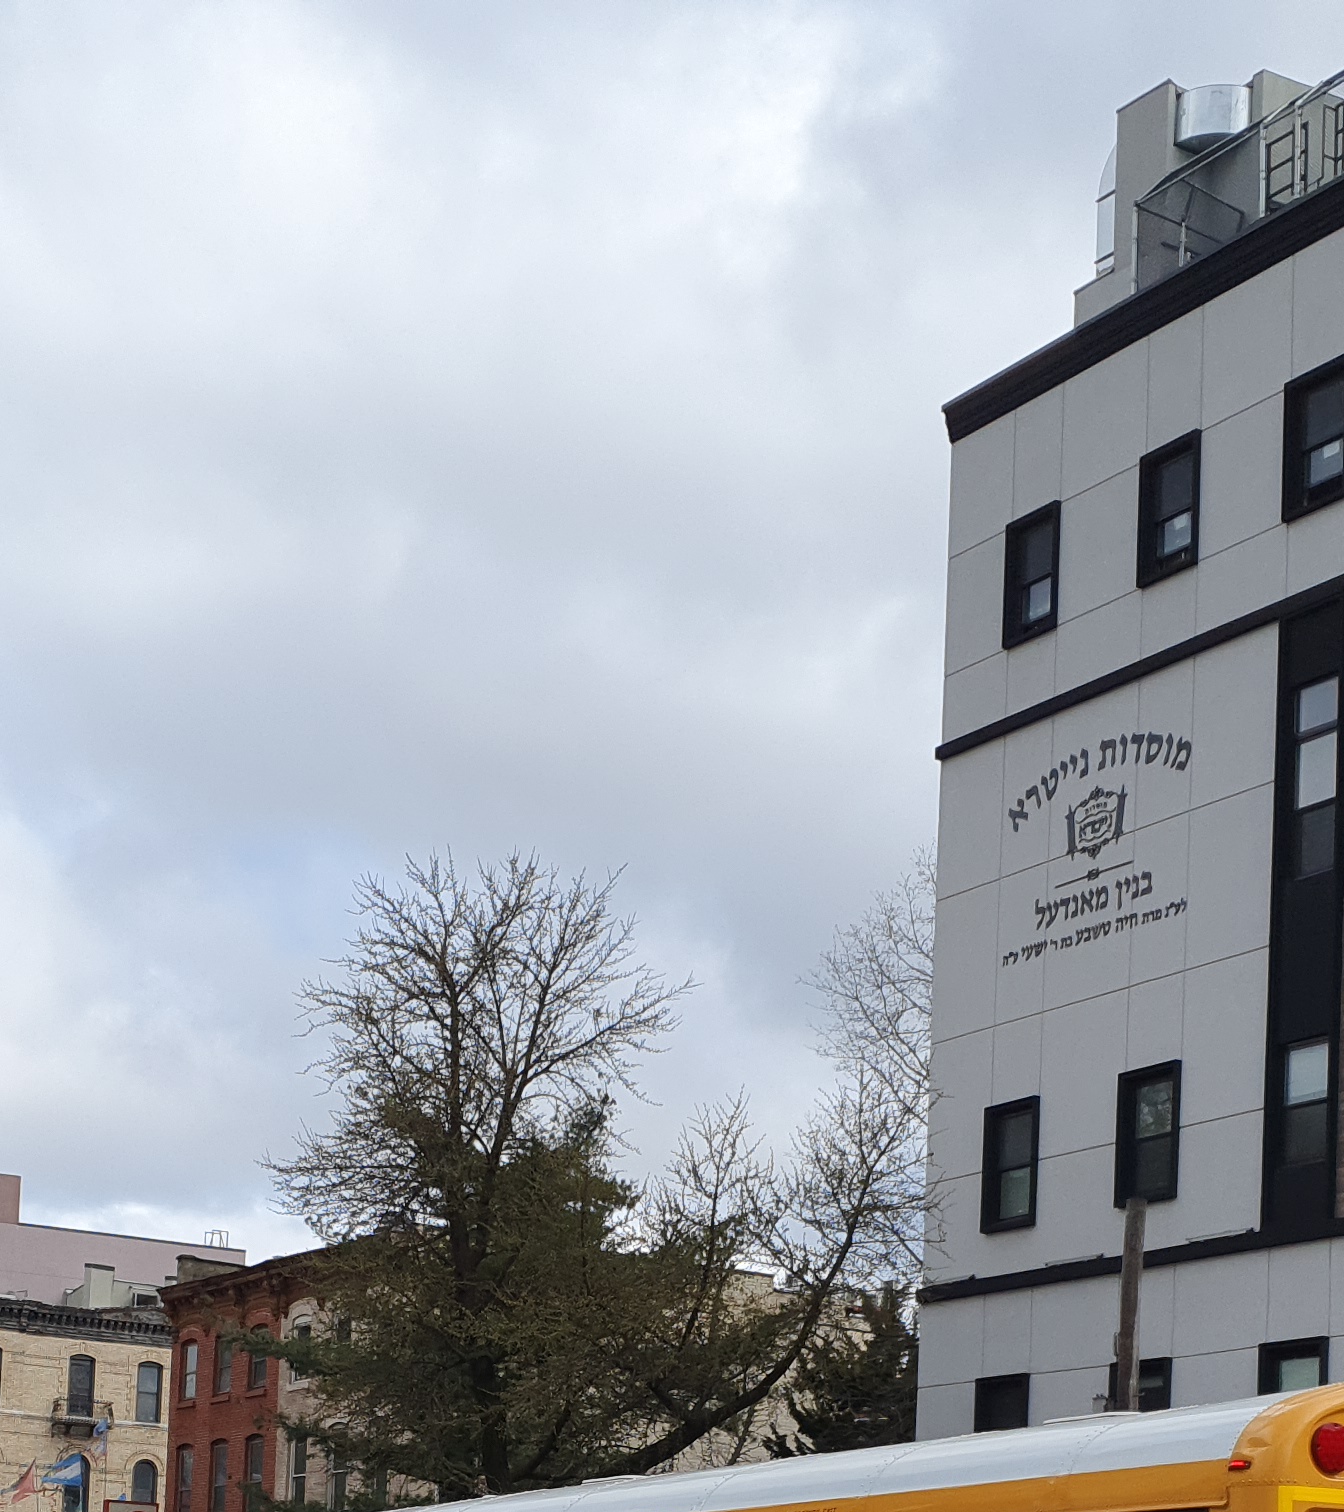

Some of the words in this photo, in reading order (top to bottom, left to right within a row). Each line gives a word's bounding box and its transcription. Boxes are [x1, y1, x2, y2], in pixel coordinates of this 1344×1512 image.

[1097, 731, 1192, 771] מוסדות
[1008, 748, 1089, 832] נייטרא
[1034, 885, 1109, 930] מאנדעל
[1115, 870, 1153, 911] בנין
